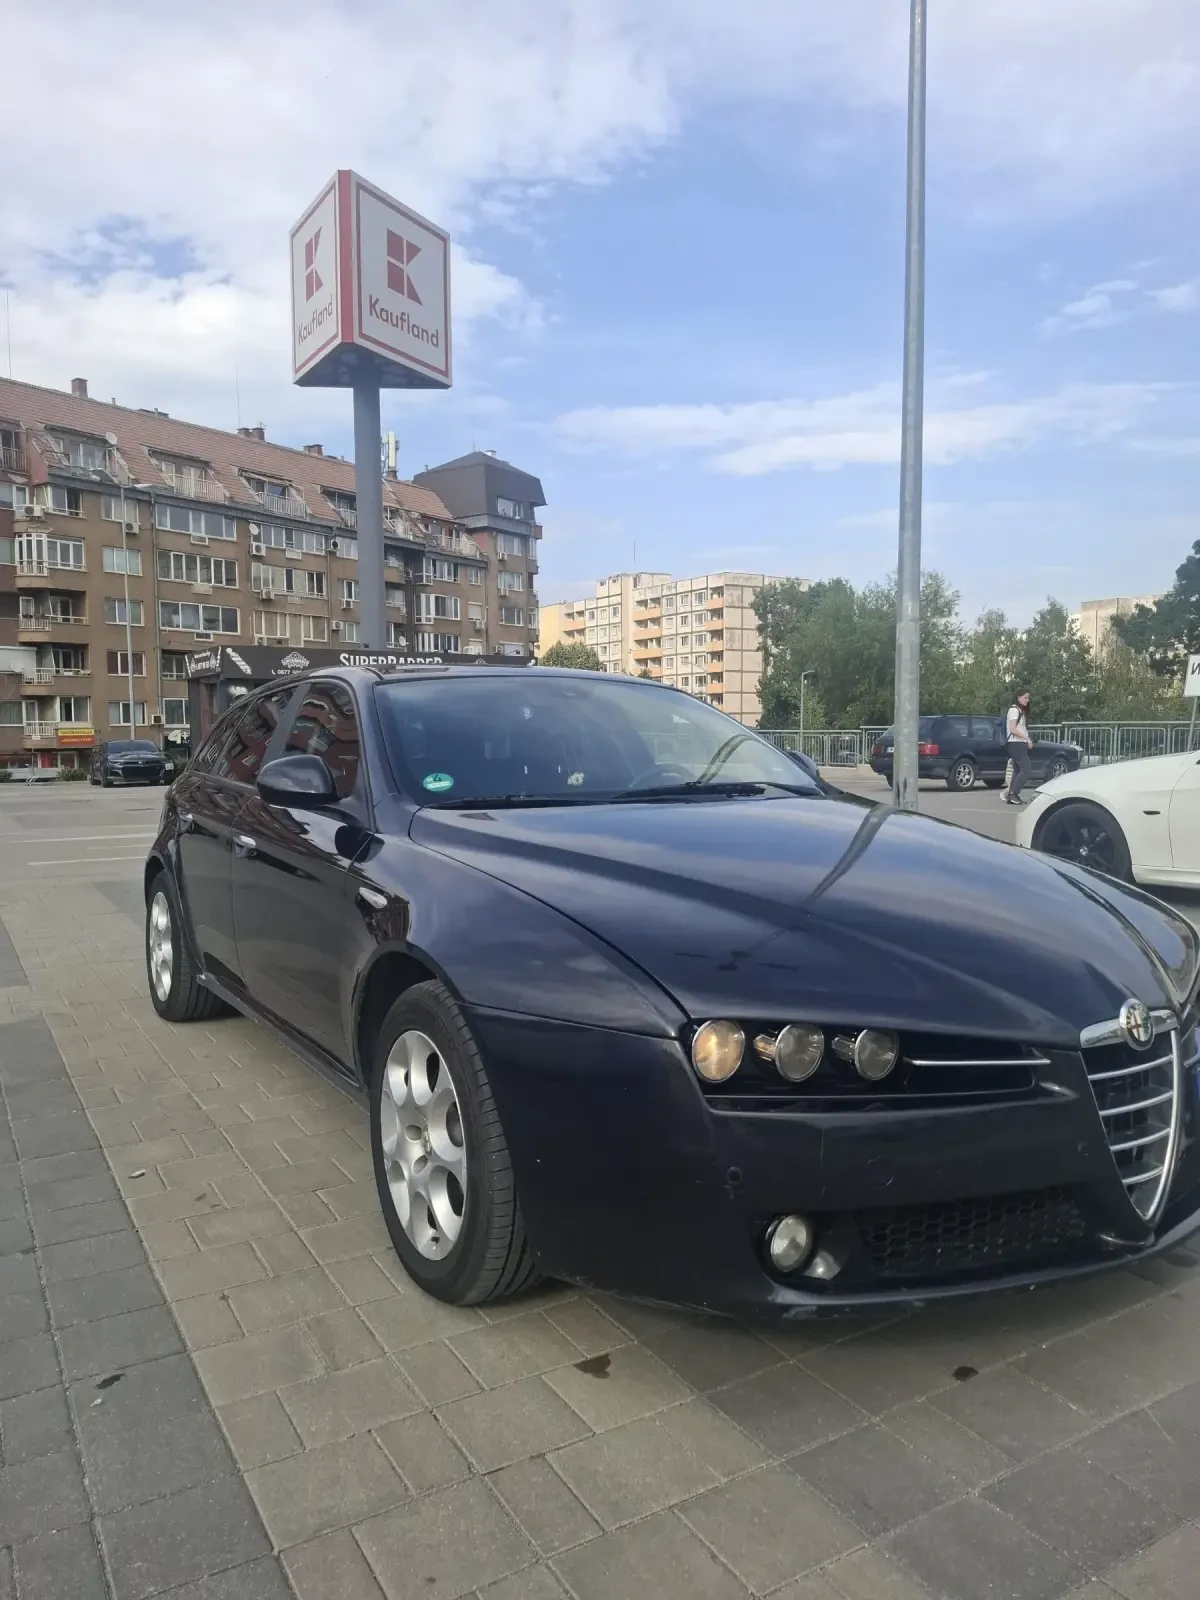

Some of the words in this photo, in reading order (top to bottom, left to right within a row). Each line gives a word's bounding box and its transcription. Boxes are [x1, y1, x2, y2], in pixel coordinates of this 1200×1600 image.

[298, 294, 333, 346] Kaufland
[368, 294, 439, 348] Kaufland
[433, 773, 442, 783] 4
